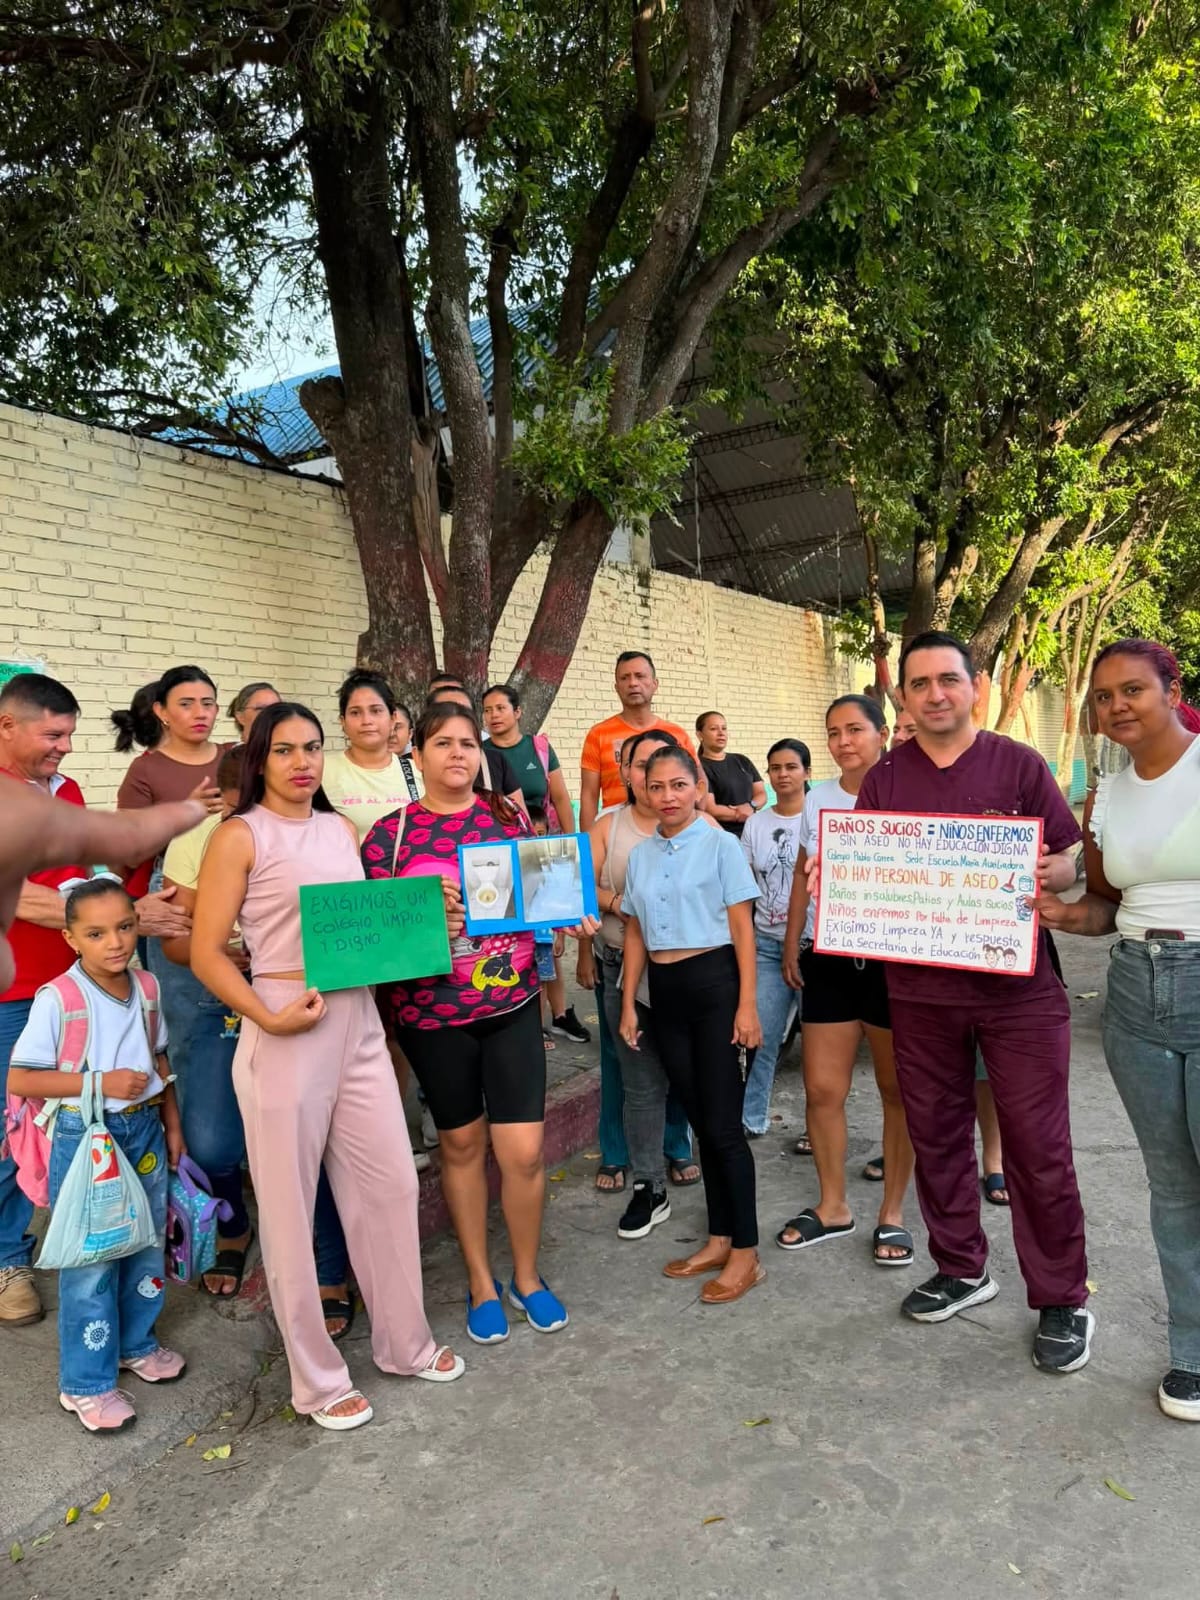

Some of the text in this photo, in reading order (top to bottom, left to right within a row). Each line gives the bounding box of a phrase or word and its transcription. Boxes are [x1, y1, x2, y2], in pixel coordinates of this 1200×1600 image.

[828, 817, 875, 834] BAÑOS
[976, 825, 1034, 843] ENFERMOS
[853, 850, 871, 862] Pablo
[905, 851, 924, 864] Sede
[927, 853, 959, 866] Escuela
[864, 836, 890, 847] ASEO
[898, 836, 911, 849] NO
[915, 837, 933, 851] HAY
[990, 843, 1029, 857] DIGNA
[832, 864, 999, 890] NO HAY PERSONAL DE ASEO
[311, 888, 428, 916] EXIGIMOS UN
[828, 881, 857, 901] Baños
[946, 897, 954, 911] y
[957, 894, 982, 908] Aulas
[828, 902, 857, 918] Niños
[956, 910, 969, 925] de
[823, 932, 837, 947] de
[911, 940, 924, 955] de
[930, 925, 943, 940] YA
[951, 933, 957, 944] y
[965, 932, 1022, 948] respuesta
